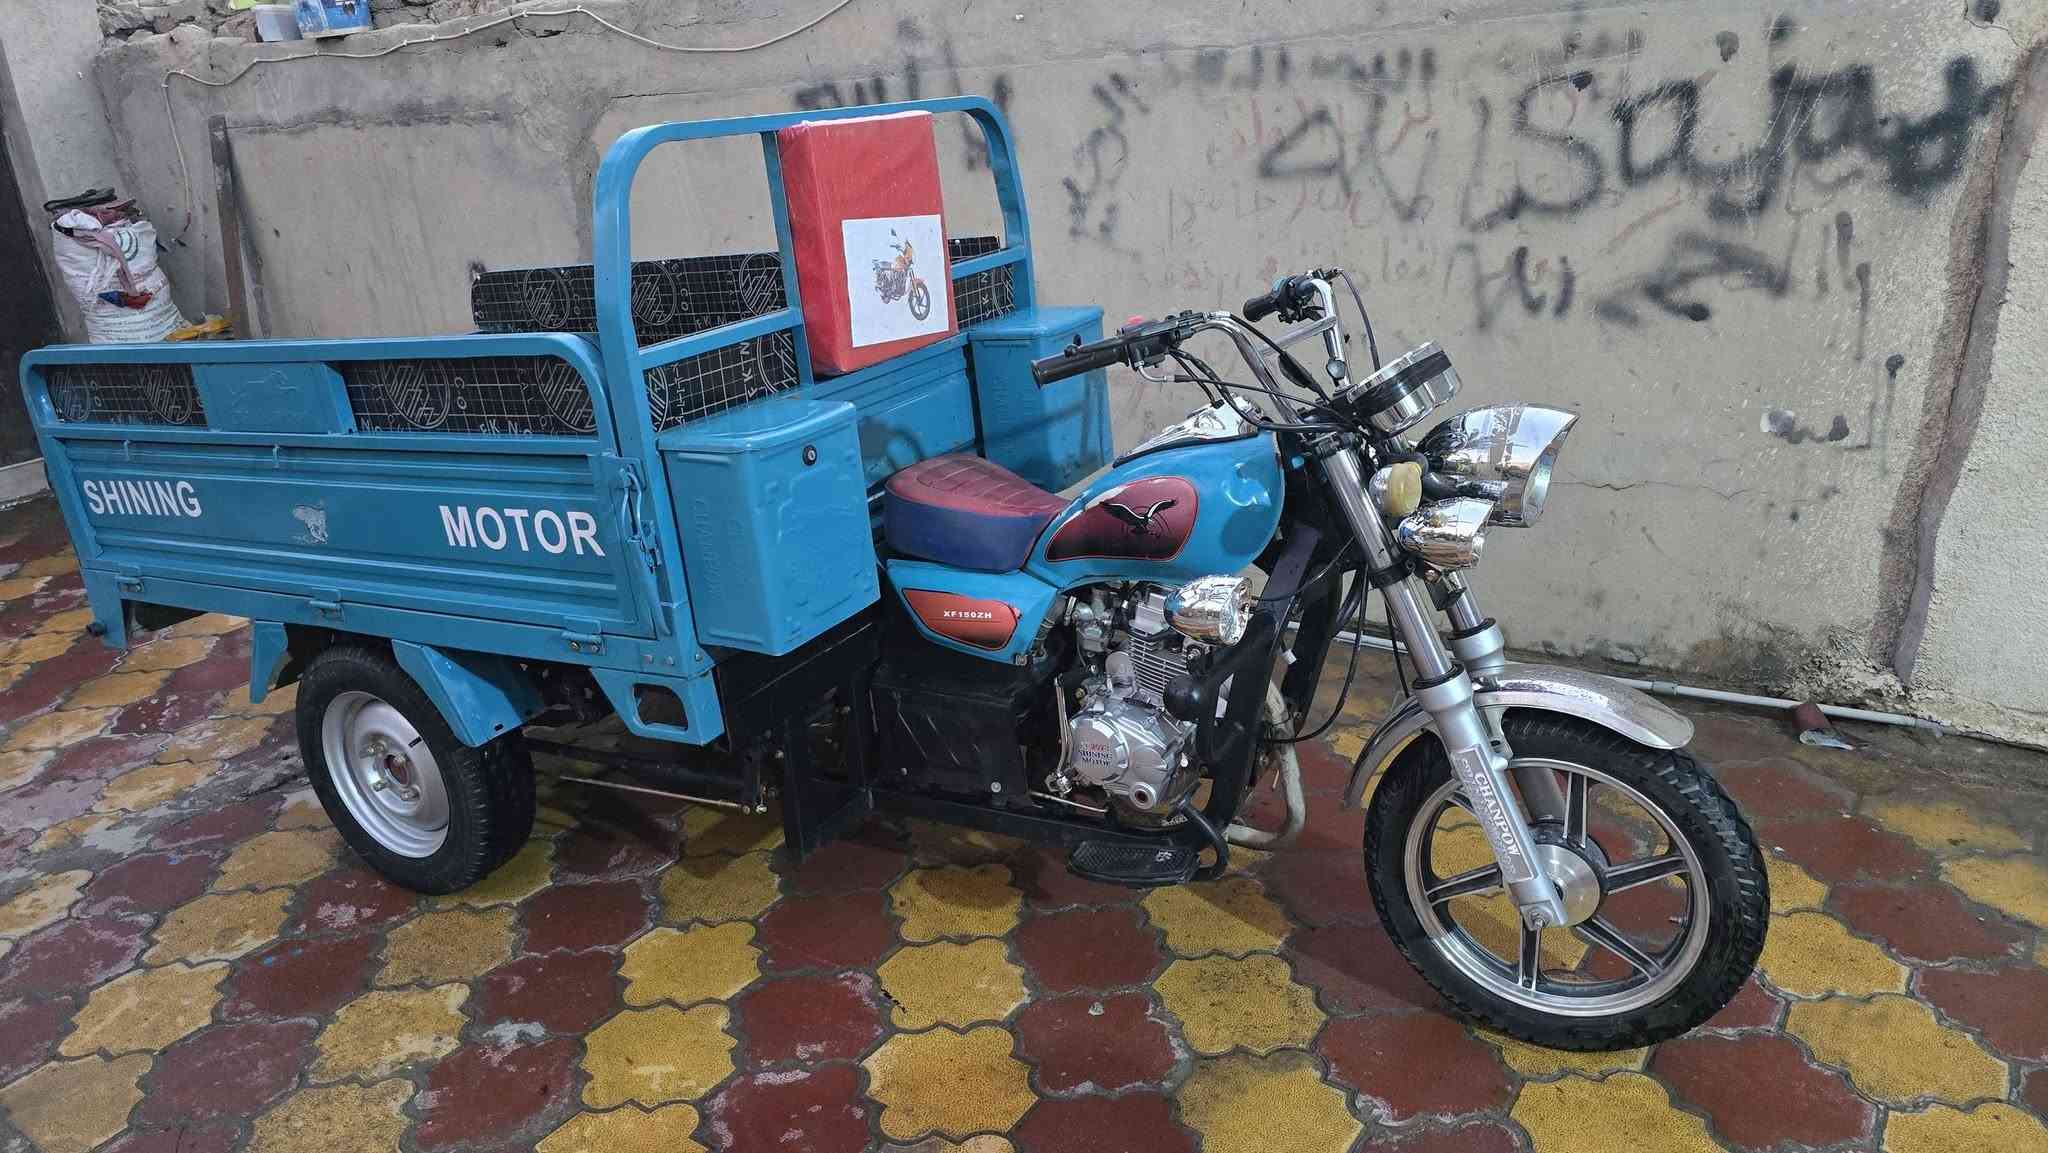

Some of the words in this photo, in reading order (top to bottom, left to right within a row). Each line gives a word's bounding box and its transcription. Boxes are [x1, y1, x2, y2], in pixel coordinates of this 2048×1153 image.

[83, 480, 202, 517] SHINING
[439, 505, 606, 557] MOTOR
[1474, 772, 1521, 857] CHANPOW
